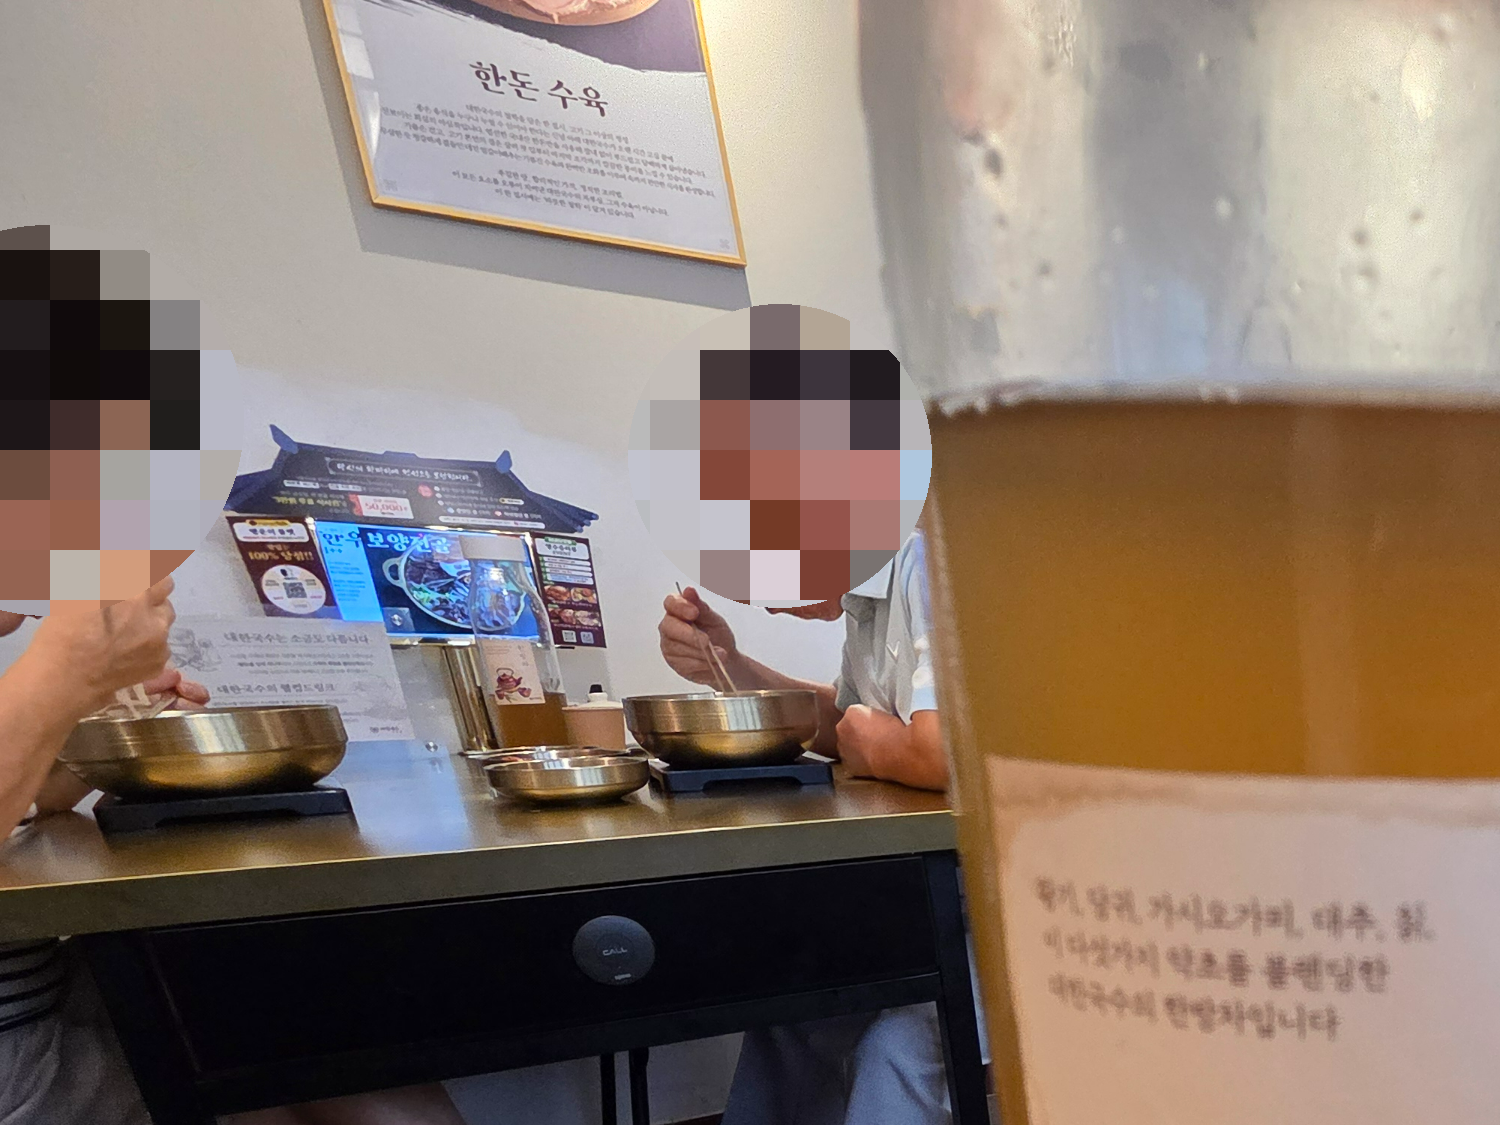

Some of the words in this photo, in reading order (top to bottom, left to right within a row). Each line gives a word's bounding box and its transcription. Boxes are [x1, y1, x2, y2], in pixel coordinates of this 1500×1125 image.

[469, 61, 539, 102] 한돈
[547, 80, 608, 117] 수육
[602, 946, 628, 956] CALL
